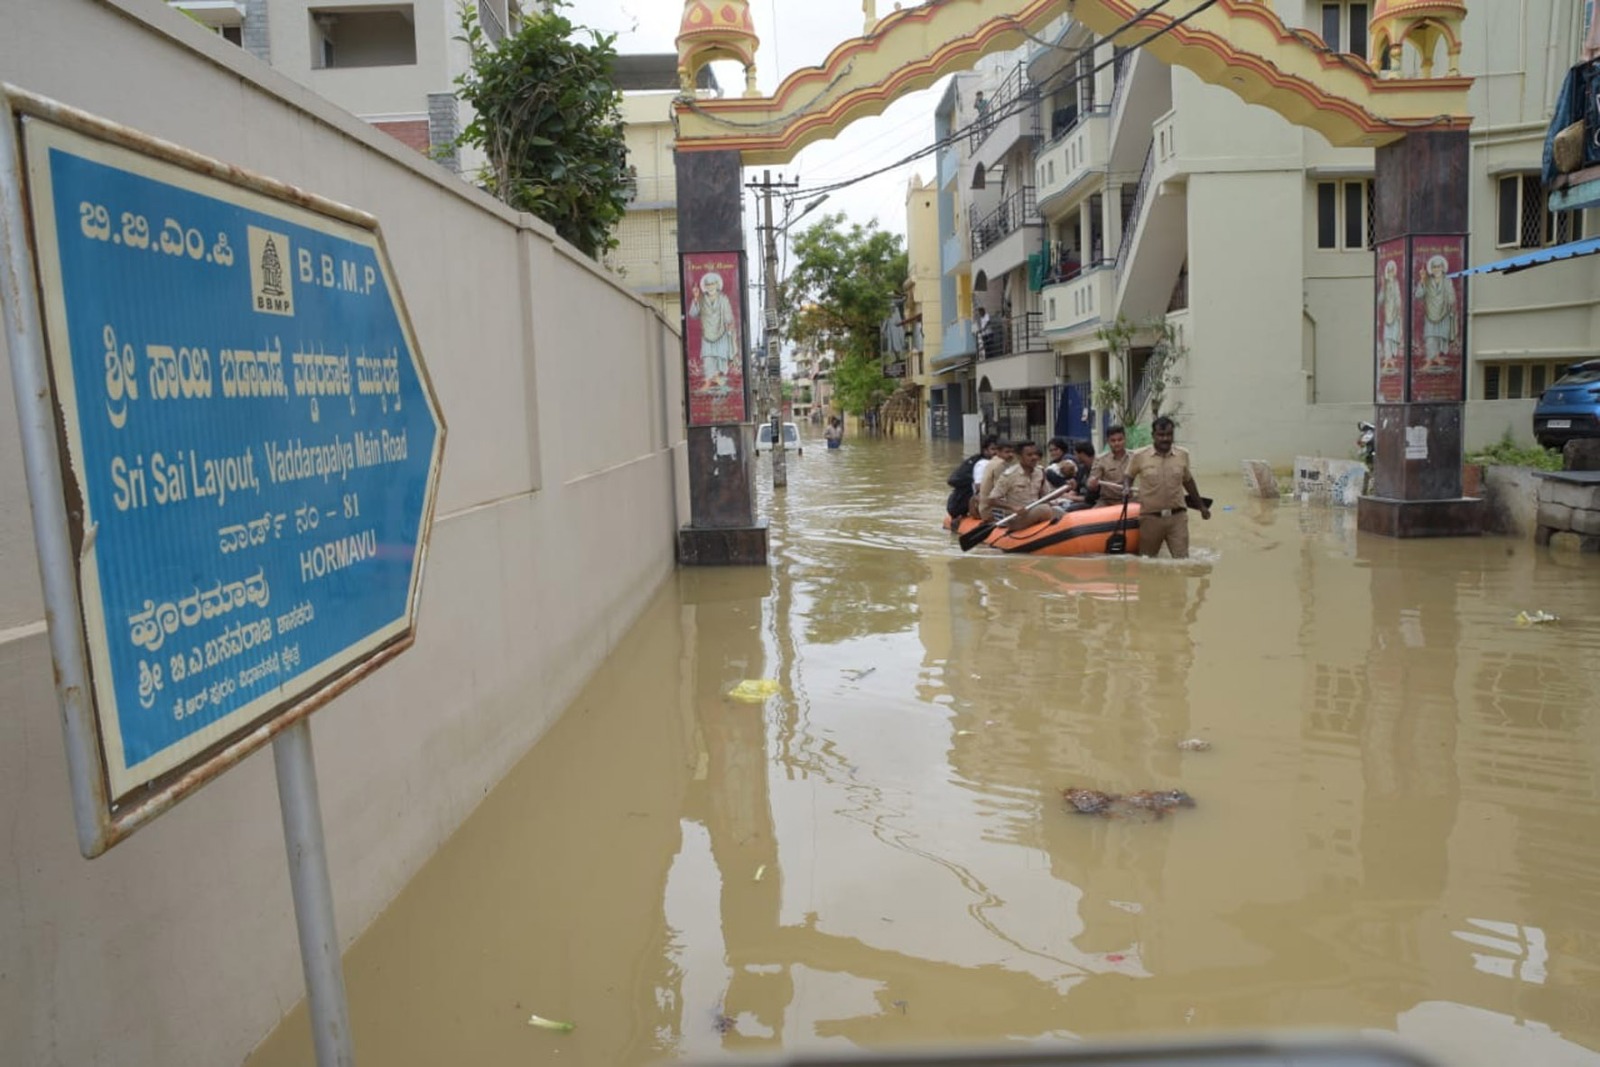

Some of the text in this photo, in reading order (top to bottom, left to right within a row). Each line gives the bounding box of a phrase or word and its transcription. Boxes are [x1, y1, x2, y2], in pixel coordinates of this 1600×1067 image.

[79, 201, 234, 266] ಬಿ.ಬಿ.ಎಂ.ಪಿ
[298, 248, 376, 295] B.B.M.P
[257, 296, 290, 312] BBMP
[103, 324, 139, 429] ಶ್ರೀ
[146, 344, 212, 399] ಸಾಯಿ
[111, 428, 407, 511] Sri Sai Layout, Vaddarapalya Main Road
[295, 502, 320, 533] ನಂ
[343, 492, 360, 519] 81
[300, 529, 377, 583] HORMAVU
[128, 566, 270, 651] ಹೊರಮಾವು
[138, 660, 164, 709] ಶ್ರೀ
